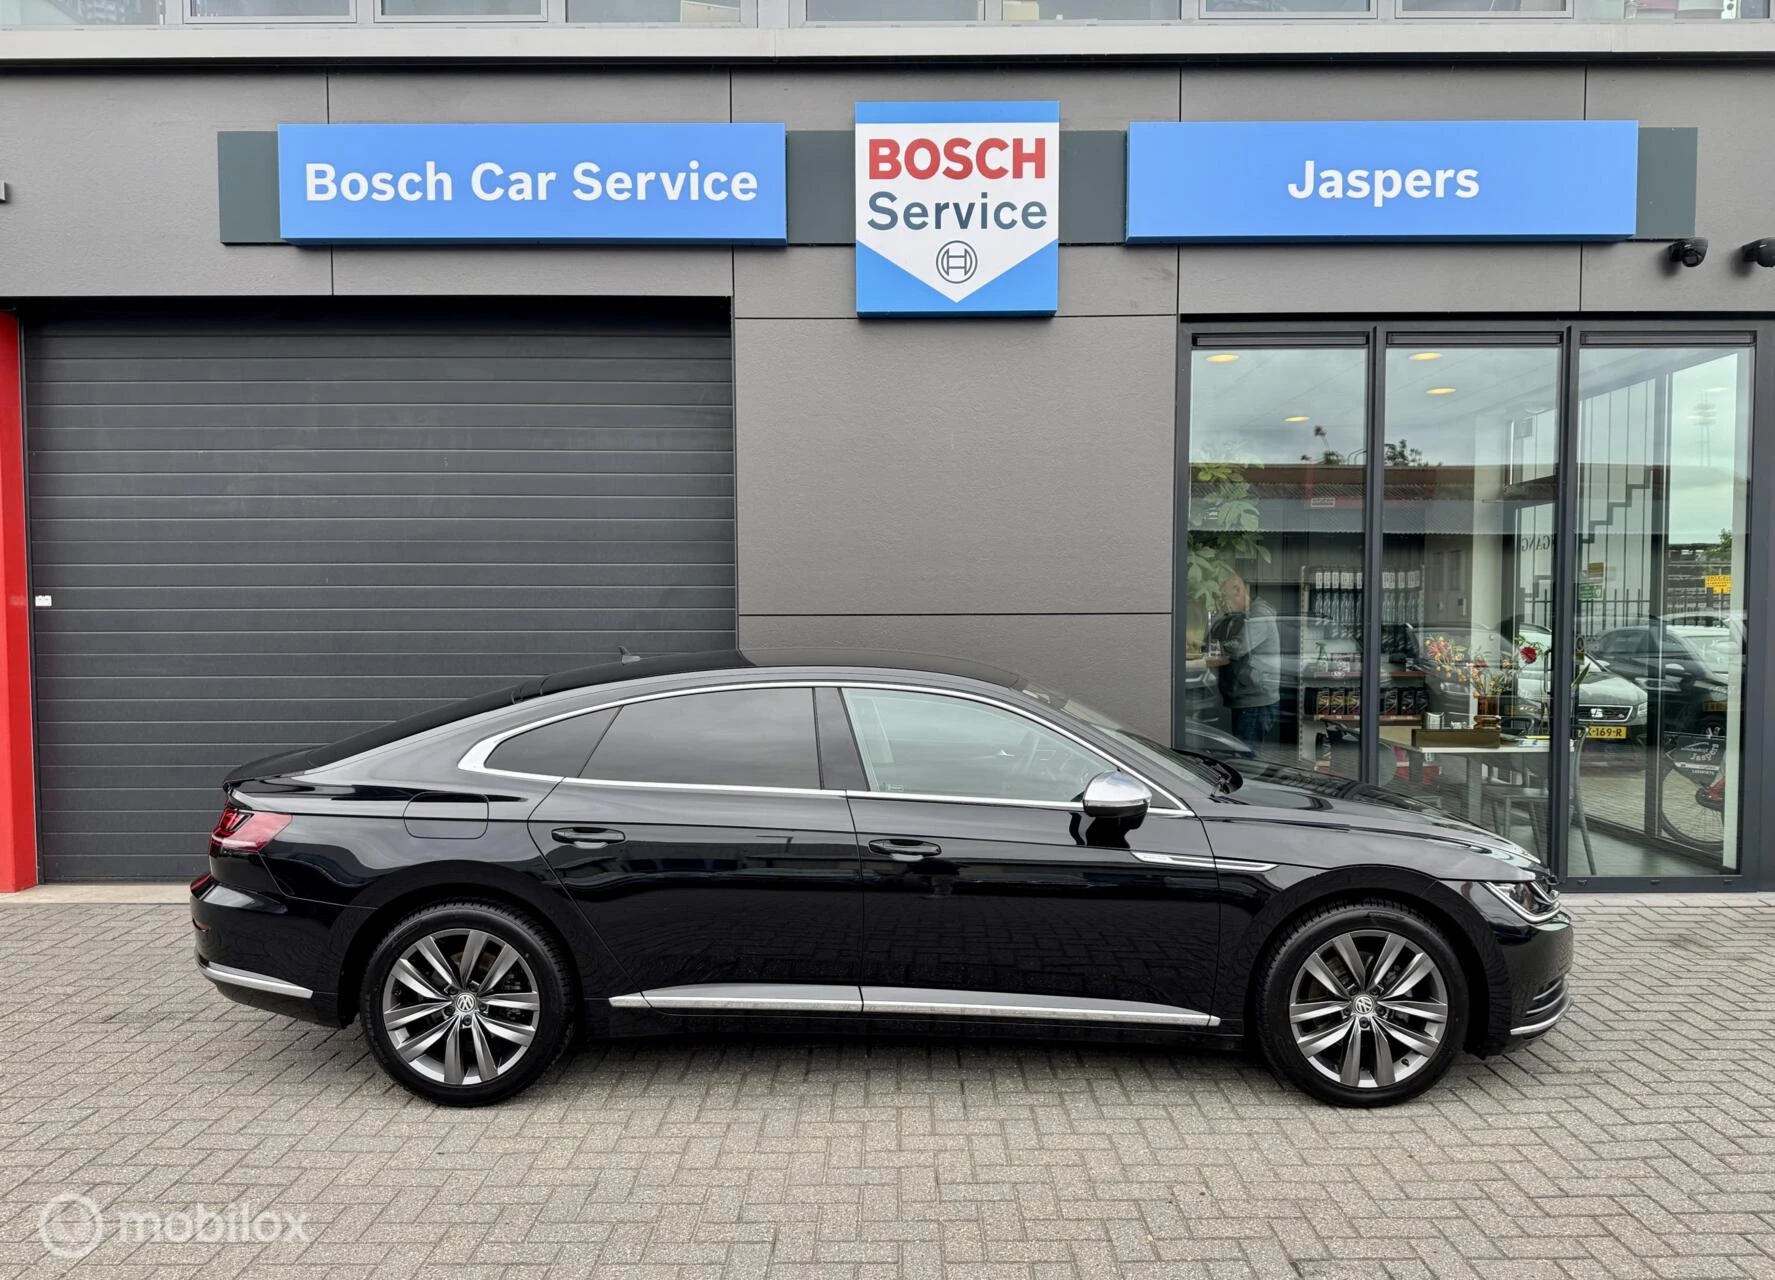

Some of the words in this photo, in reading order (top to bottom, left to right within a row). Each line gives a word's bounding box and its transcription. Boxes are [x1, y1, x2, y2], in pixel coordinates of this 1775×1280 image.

[868, 138, 1046, 180] BOSCH
[305, 160, 453, 202] Bosch
[471, 162, 557, 202] Car
[572, 160, 758, 202] Service
[1288, 160, 1480, 208] Jaspers
[867, 191, 1047, 231] Service
